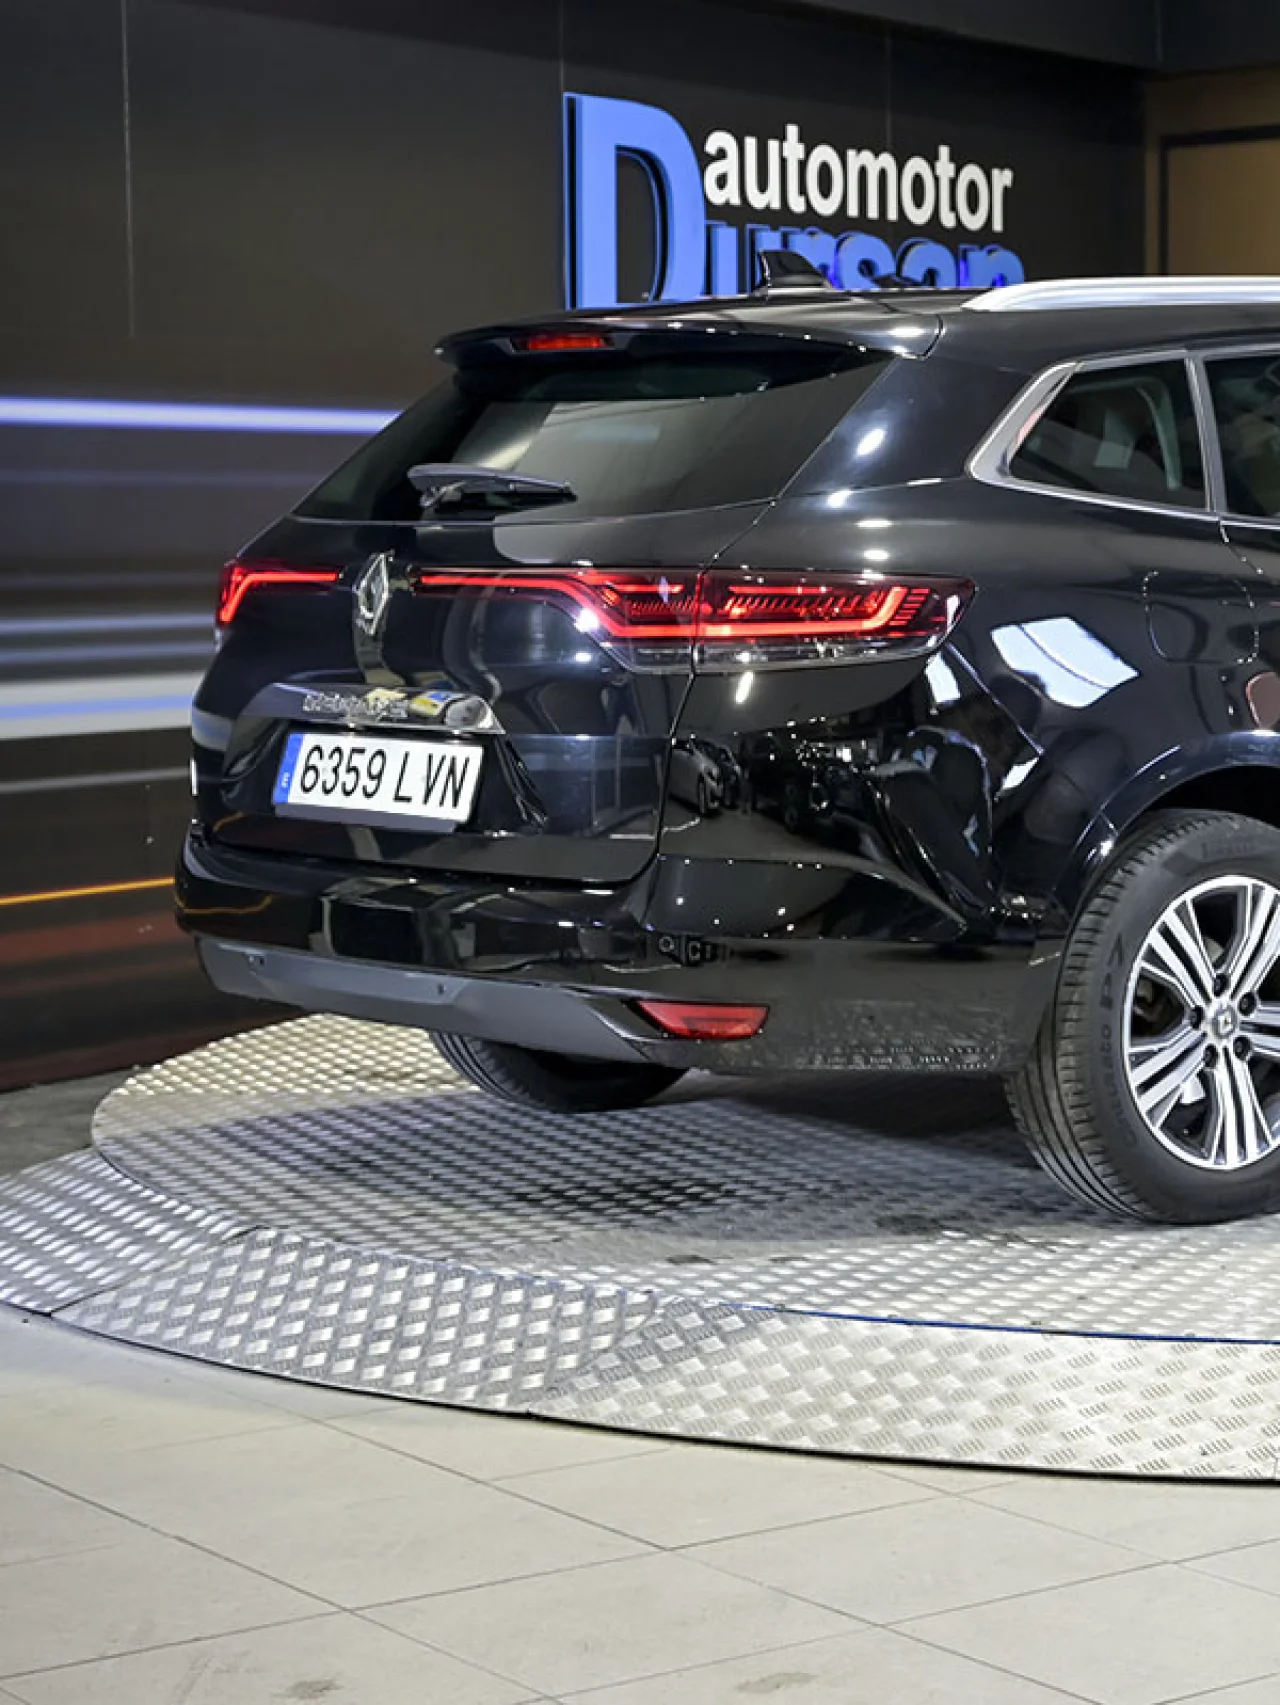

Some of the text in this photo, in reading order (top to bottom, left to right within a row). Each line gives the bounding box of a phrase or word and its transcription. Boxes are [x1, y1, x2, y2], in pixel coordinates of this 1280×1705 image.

[704, 123, 1013, 232] automotor
[300, 744, 470, 809] 6359 LVN
